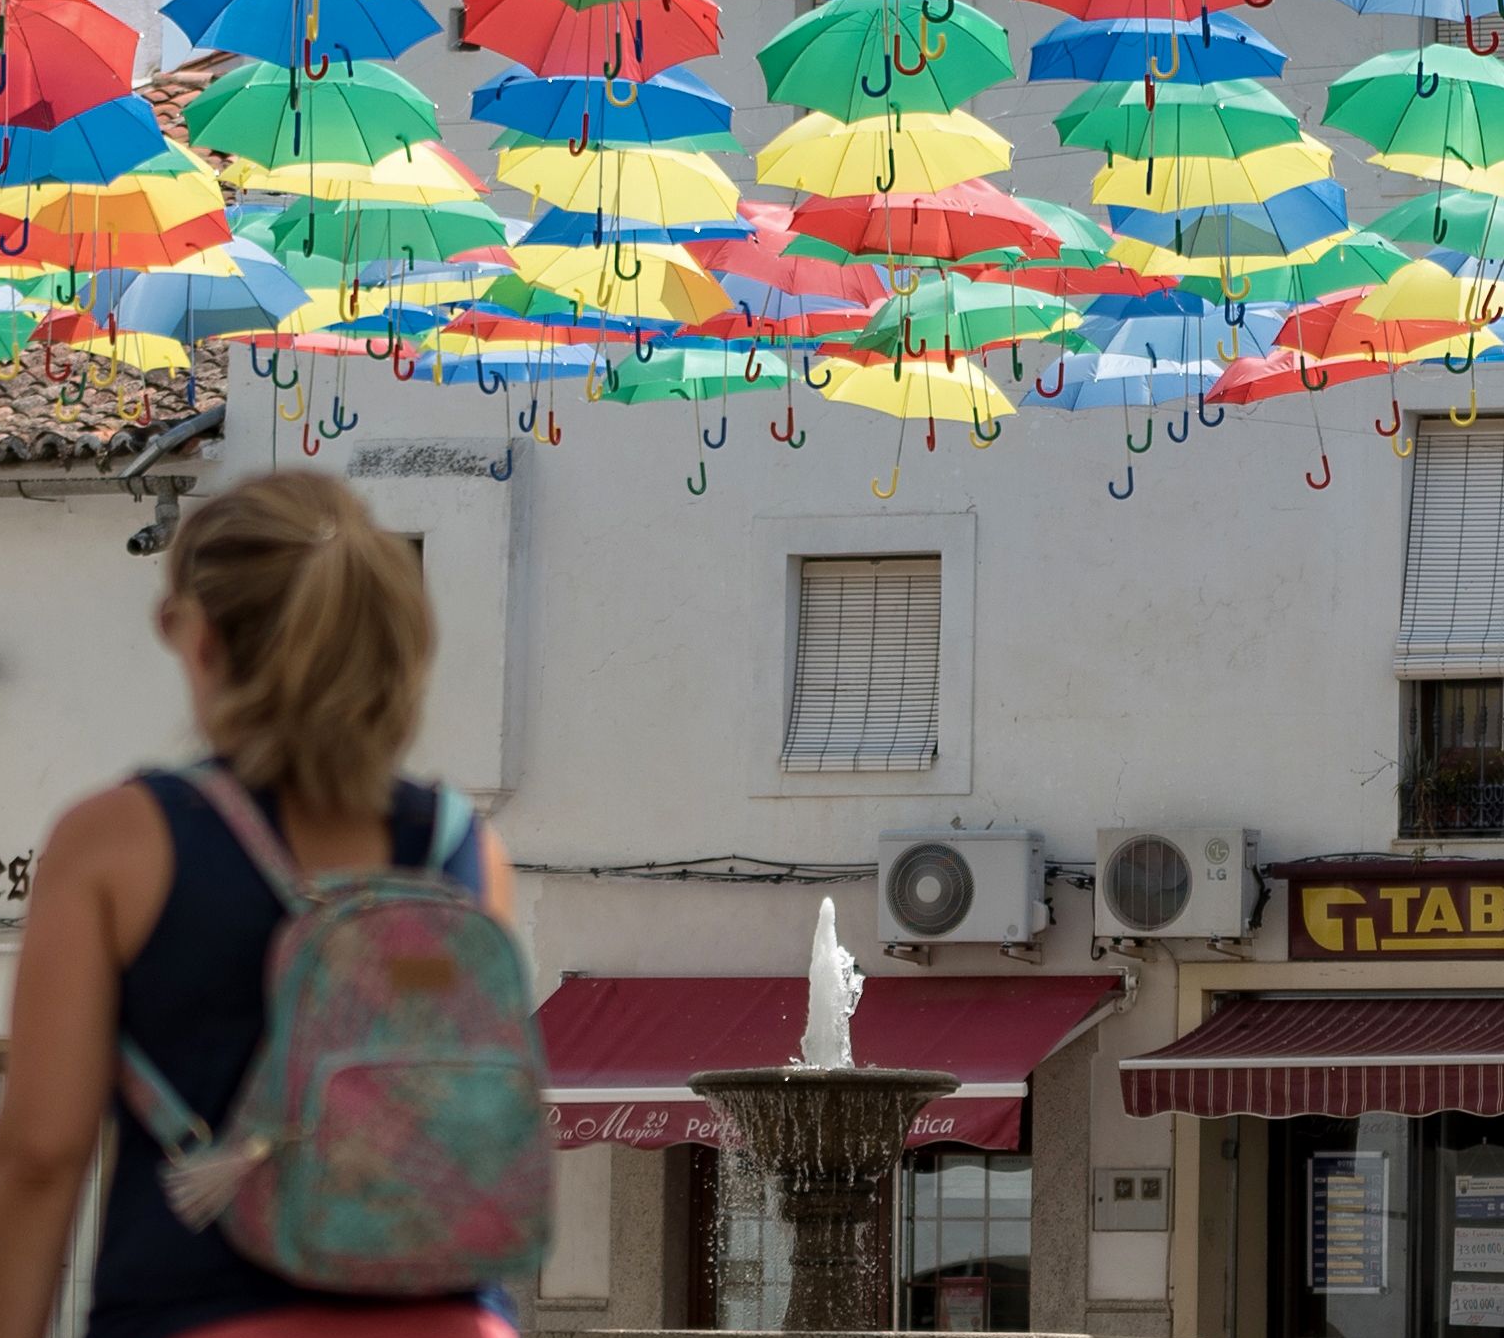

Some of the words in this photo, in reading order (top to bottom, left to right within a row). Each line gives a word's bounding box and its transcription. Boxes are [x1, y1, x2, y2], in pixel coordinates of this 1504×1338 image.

[1207, 868, 1227, 881] LG
[575, 1105, 665, 1146] Mayor
[643, 1111, 668, 1128] 29
[685, 1118, 743, 1139] Perfu
[908, 1114, 956, 1135] tica
